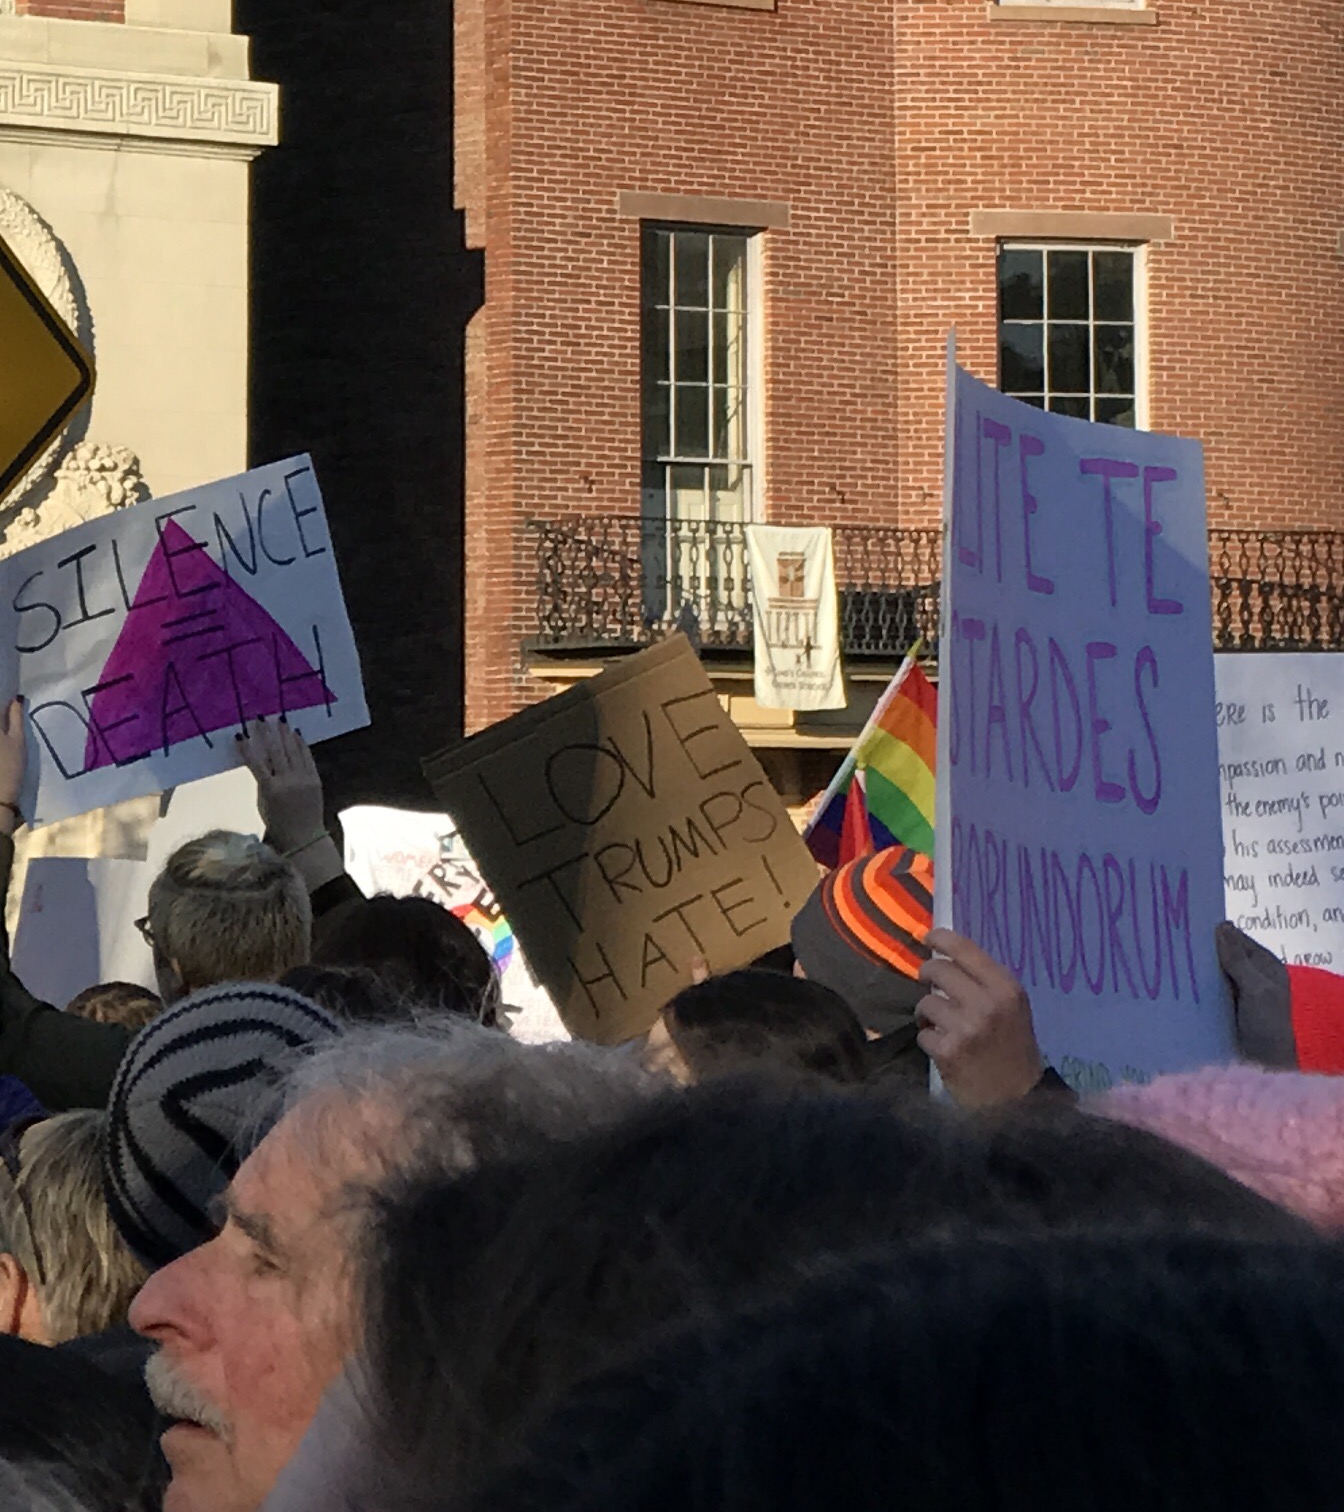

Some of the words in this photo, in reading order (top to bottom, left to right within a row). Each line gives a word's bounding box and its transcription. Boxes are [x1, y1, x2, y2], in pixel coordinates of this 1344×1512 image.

[12, 466, 327, 653] SILENCE
[1079, 457, 1185, 616] TE
[29, 624, 327, 781] DEATH
[478, 688, 743, 847] LOVE
[950, 608, 1163, 816] STARDES
[1294, 683, 1331, 722] the
[1295, 746, 1327, 773] and
[515, 780, 778, 934] TRUMPS
[1225, 791, 1253, 818] the
[1232, 828, 1259, 859] his
[1268, 861, 1321, 889] indeed
[566, 853, 792, 1020] HATE!
[1236, 903, 1318, 933] condition,
